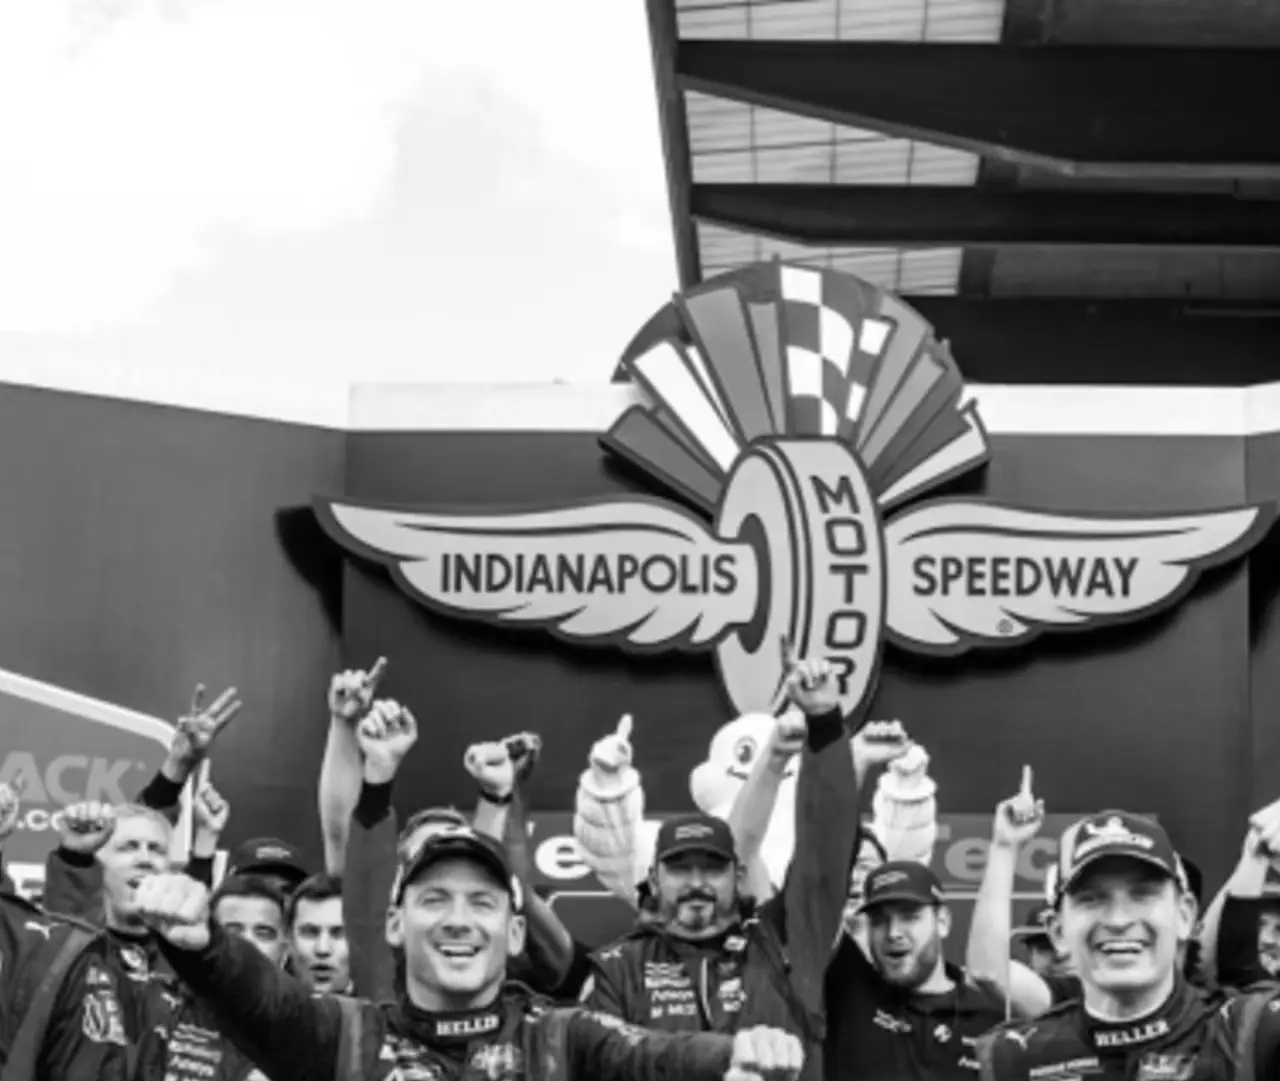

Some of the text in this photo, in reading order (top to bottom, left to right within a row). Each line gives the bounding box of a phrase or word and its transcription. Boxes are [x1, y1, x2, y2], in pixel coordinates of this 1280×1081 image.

[440, 475, 1140, 695] INDIANAPOLIS MOTOR SPEEDWAY
